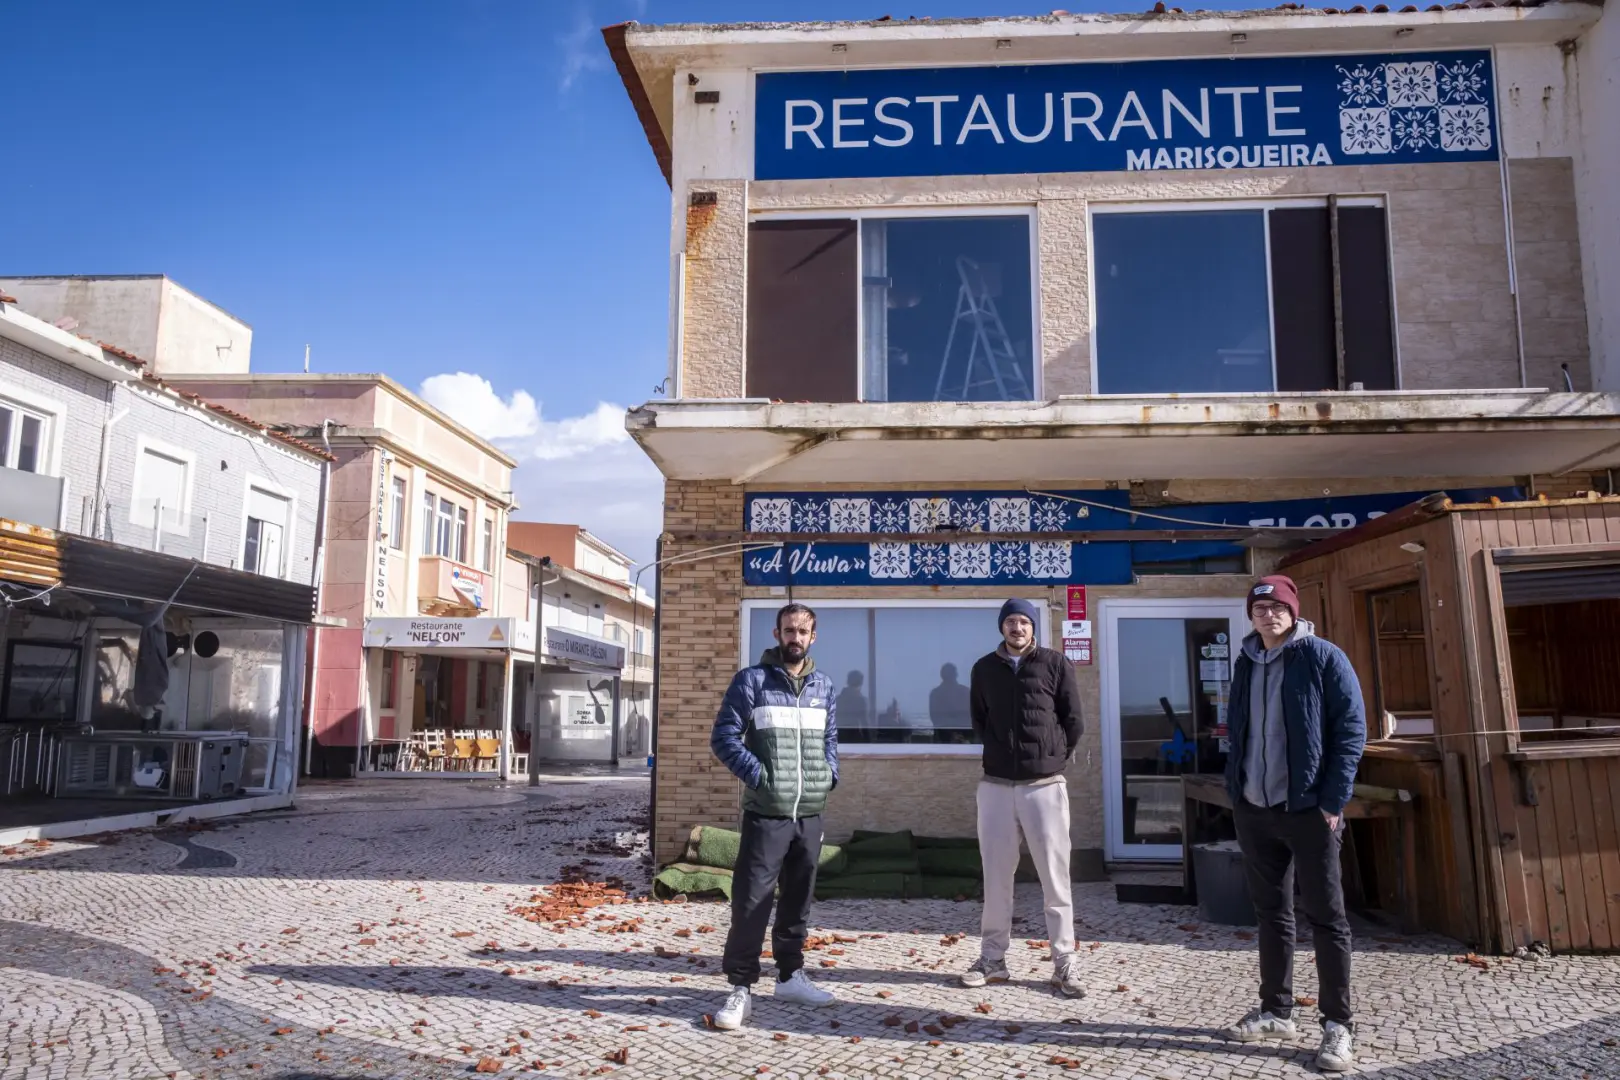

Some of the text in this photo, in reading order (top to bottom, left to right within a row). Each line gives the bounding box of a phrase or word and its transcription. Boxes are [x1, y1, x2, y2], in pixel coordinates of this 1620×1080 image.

[784, 85, 1307, 150] RESTAURANTE
[1126, 142, 1334, 171] MARISQUEIRA
[375, 546, 387, 609] NELSON
[411, 622, 463, 630] Restaurante
